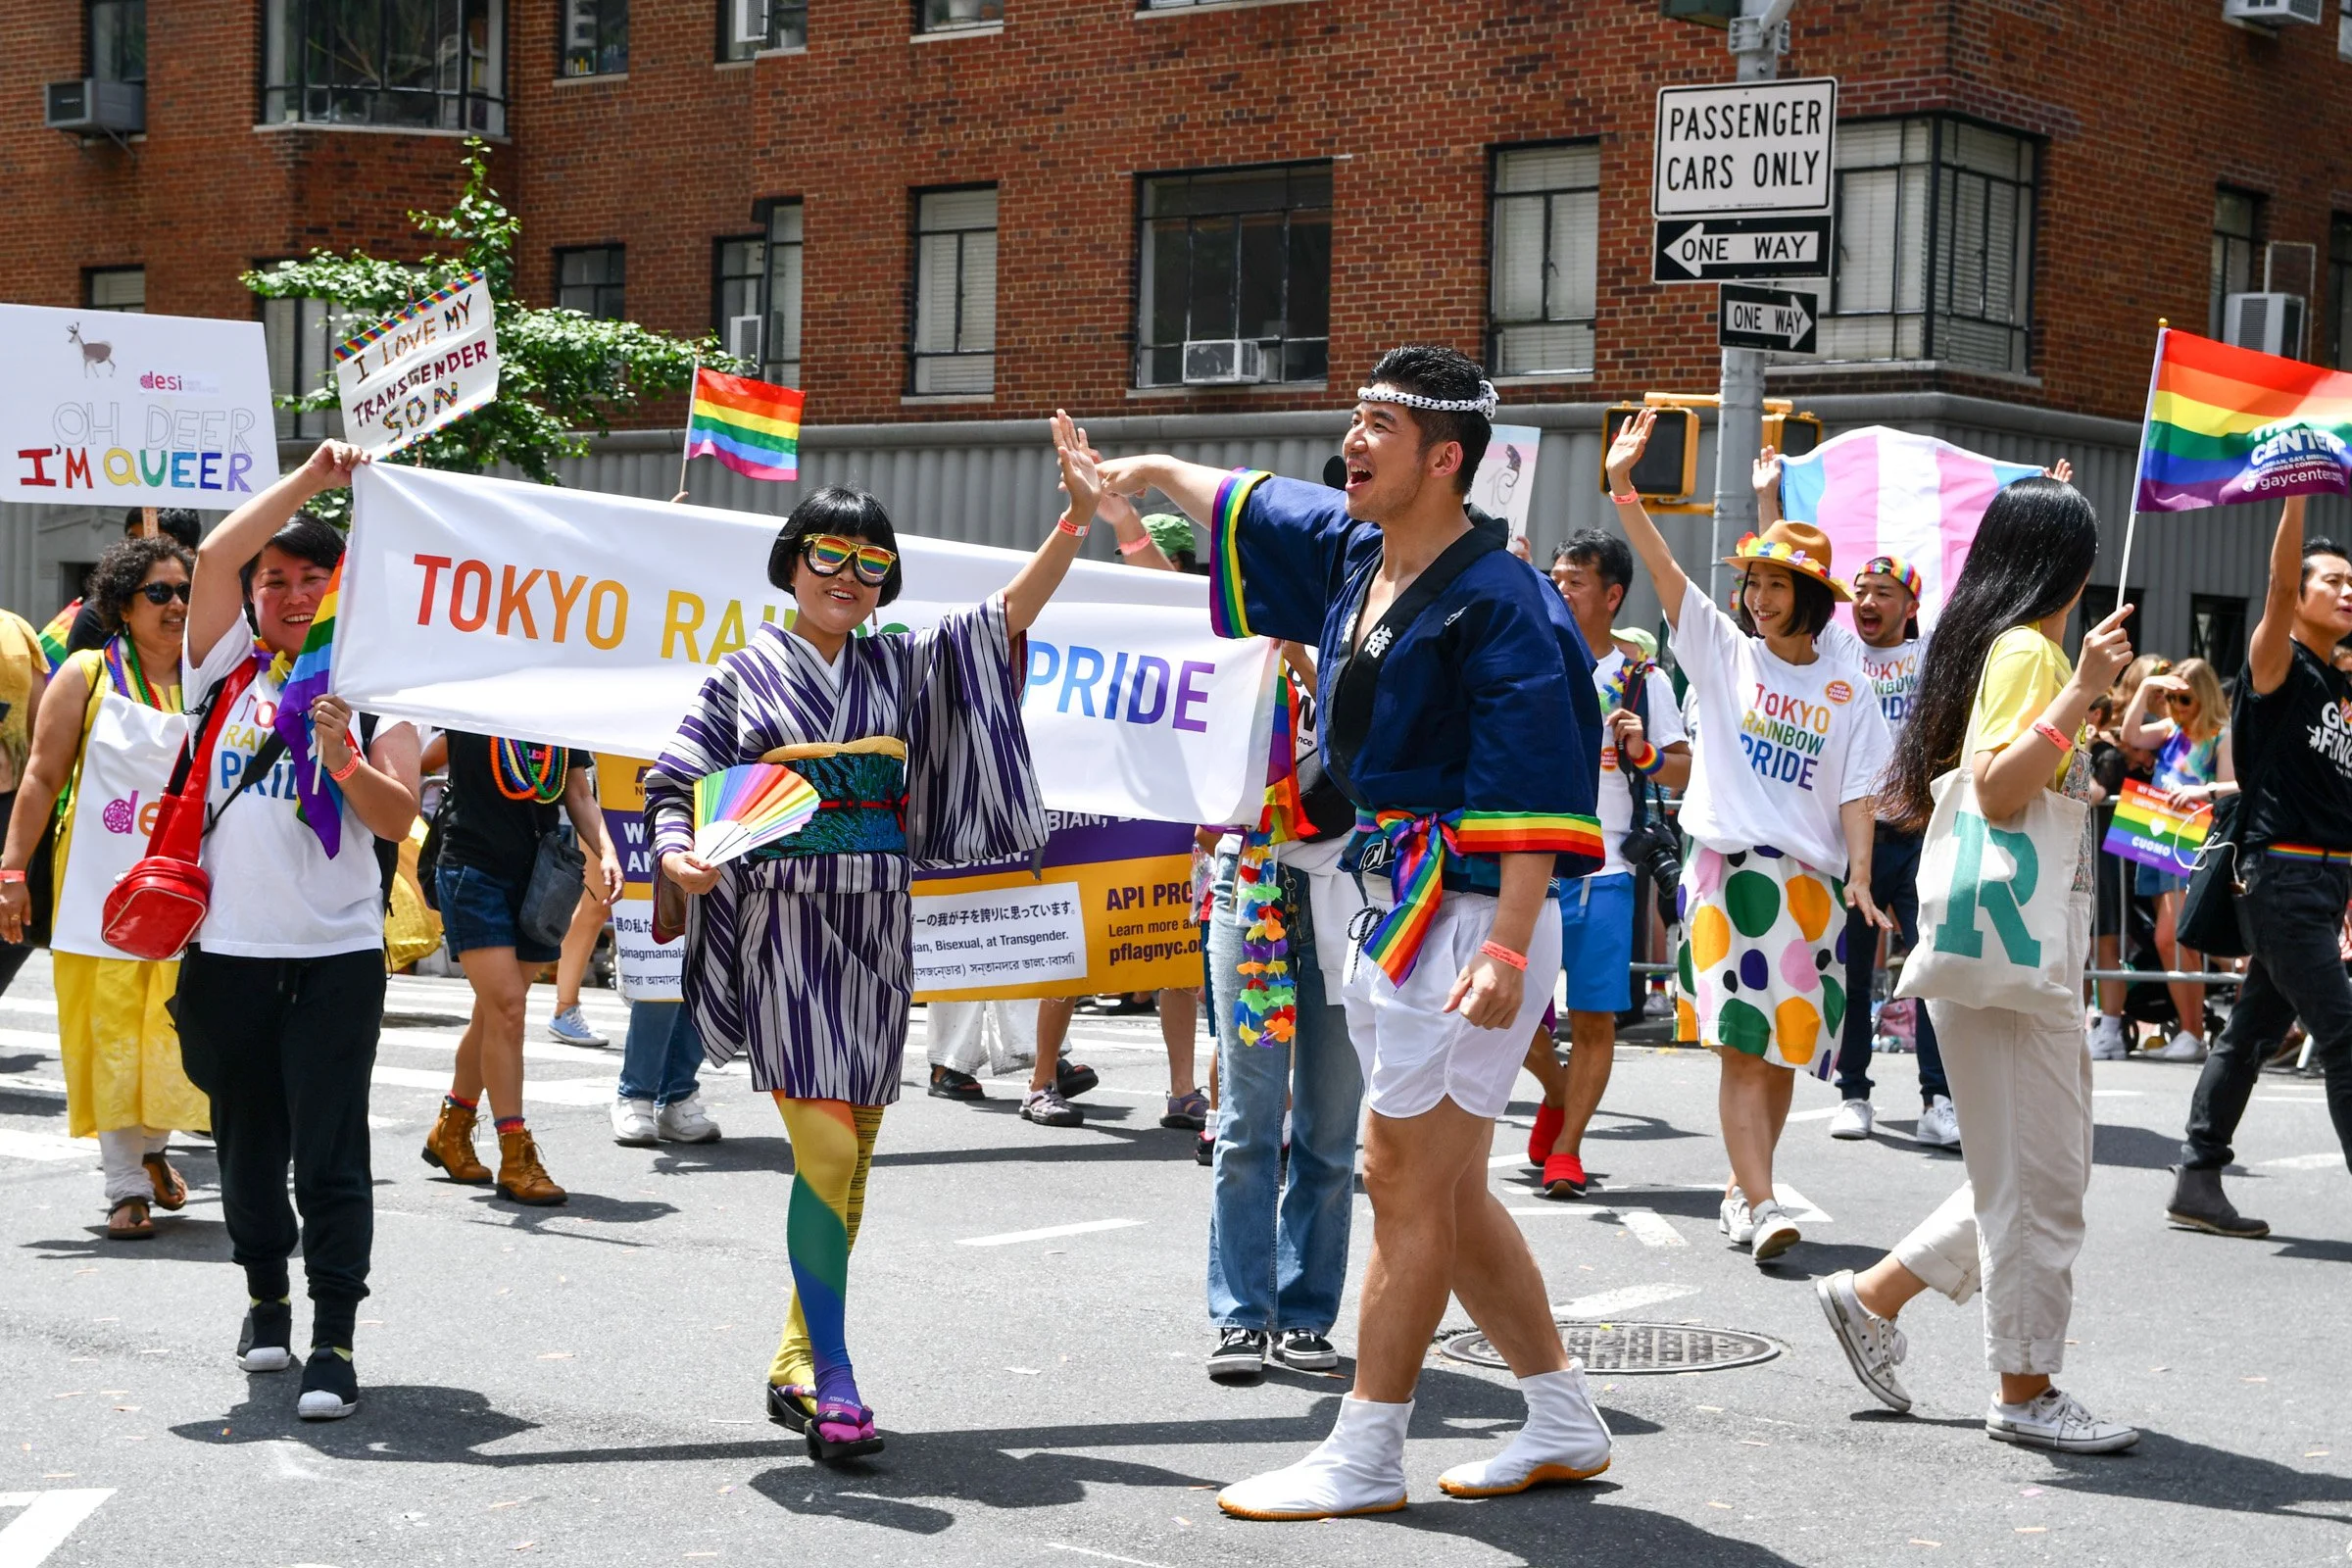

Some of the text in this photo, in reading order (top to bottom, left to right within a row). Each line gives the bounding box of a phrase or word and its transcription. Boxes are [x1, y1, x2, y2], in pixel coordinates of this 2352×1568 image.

[1670, 100, 1821, 141] PASSENGER
[1668, 150, 1820, 191] CARS ONLY
[1682, 235, 1807, 262] ONE WAY
[354, 294, 471, 384] I LOVE MY
[1734, 305, 1803, 333] ONE WAY
[140, 370, 182, 391] desi
[353, 340, 488, 427] TRANSGENDER
[53, 402, 255, 454] OH DEER
[383, 381, 458, 446] SON
[18, 444, 253, 493] I'M QUEER
[414, 554, 629, 651] TOKYO
[1021, 640, 1215, 733] PRIDE
[1754, 683, 1831, 734] TOKYO
[1741, 710, 1826, 757] RAINBOW
[2132, 835, 2172, 858] CUOMO
[1106, 885, 1145, 910] API
[1934, 810, 2041, 968] R
[935, 937, 984, 953] Bisexual,
[986, 935, 998, 948] at
[1000, 930, 1069, 948] Transgender.
[1108, 923, 1144, 938] Learn
[1148, 920, 1179, 933] more
